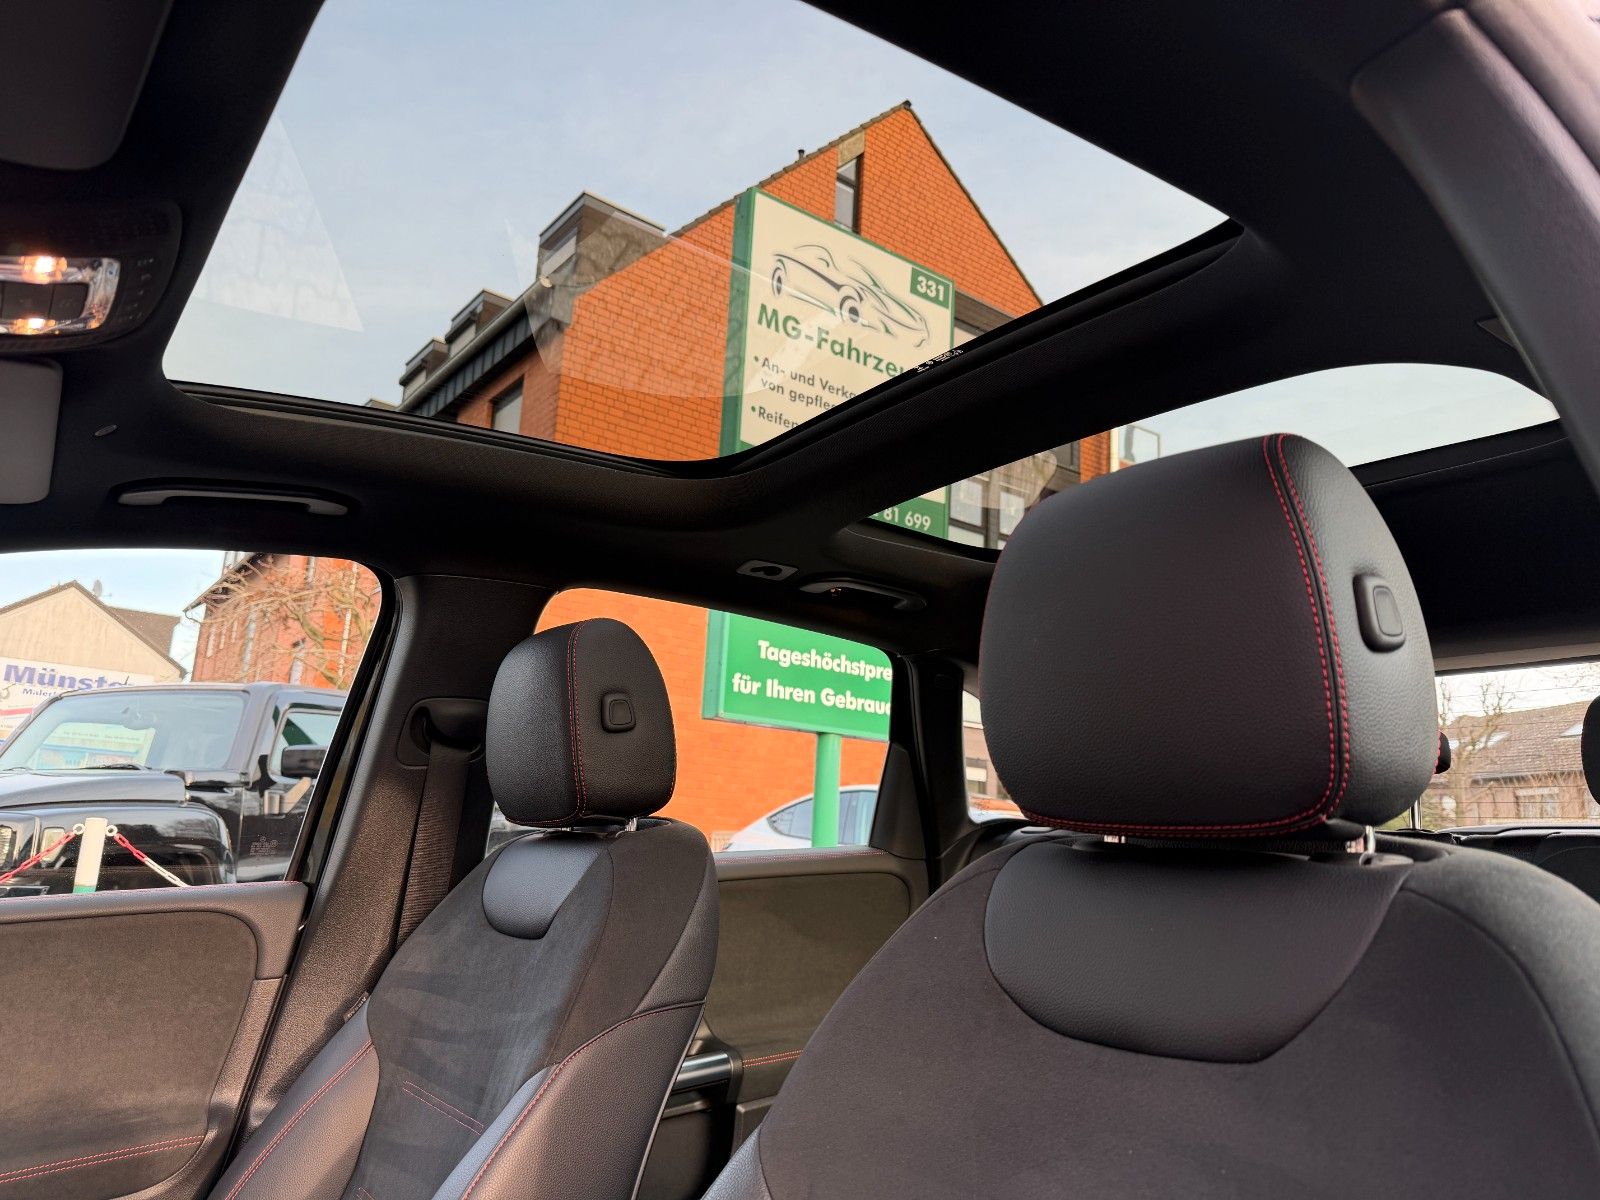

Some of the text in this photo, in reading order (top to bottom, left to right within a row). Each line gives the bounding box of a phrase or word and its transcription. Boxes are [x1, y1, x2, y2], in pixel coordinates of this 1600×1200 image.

[916, 275, 945, 302] 331
[761, 357, 786, 374] An-
[790, 371, 815, 387] und
[761, 378, 784, 395] von
[905, 511, 931, 531] 699
[758, 640, 892, 682] Tageshöchstpre
[732, 673, 761, 695] für
[766, 678, 816, 704] Ihren
